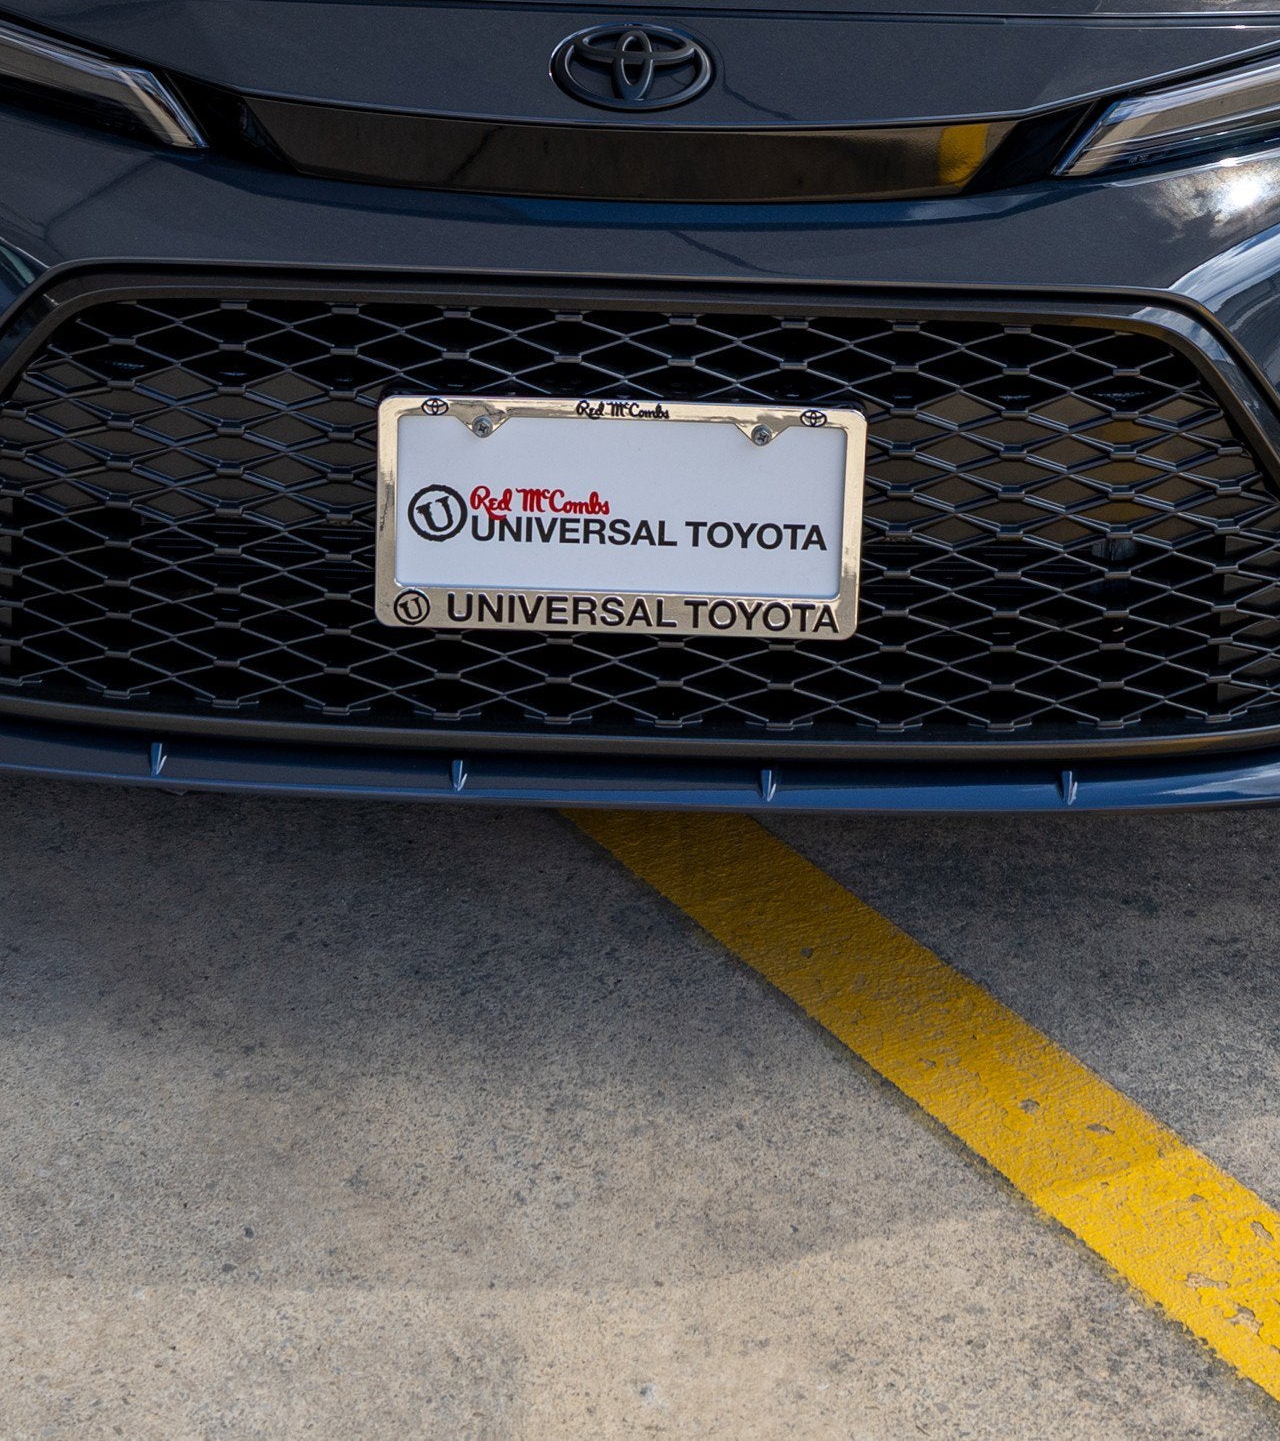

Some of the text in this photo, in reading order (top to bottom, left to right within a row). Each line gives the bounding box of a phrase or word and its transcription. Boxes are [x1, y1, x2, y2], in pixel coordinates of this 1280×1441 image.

[576, 400, 605, 419] Red
[470, 486, 610, 520] Red McCombs
[471, 515, 827, 551] UNIVERSAL TOYOTA
[447, 592, 840, 633] UNIVERSAL TOYOTA
